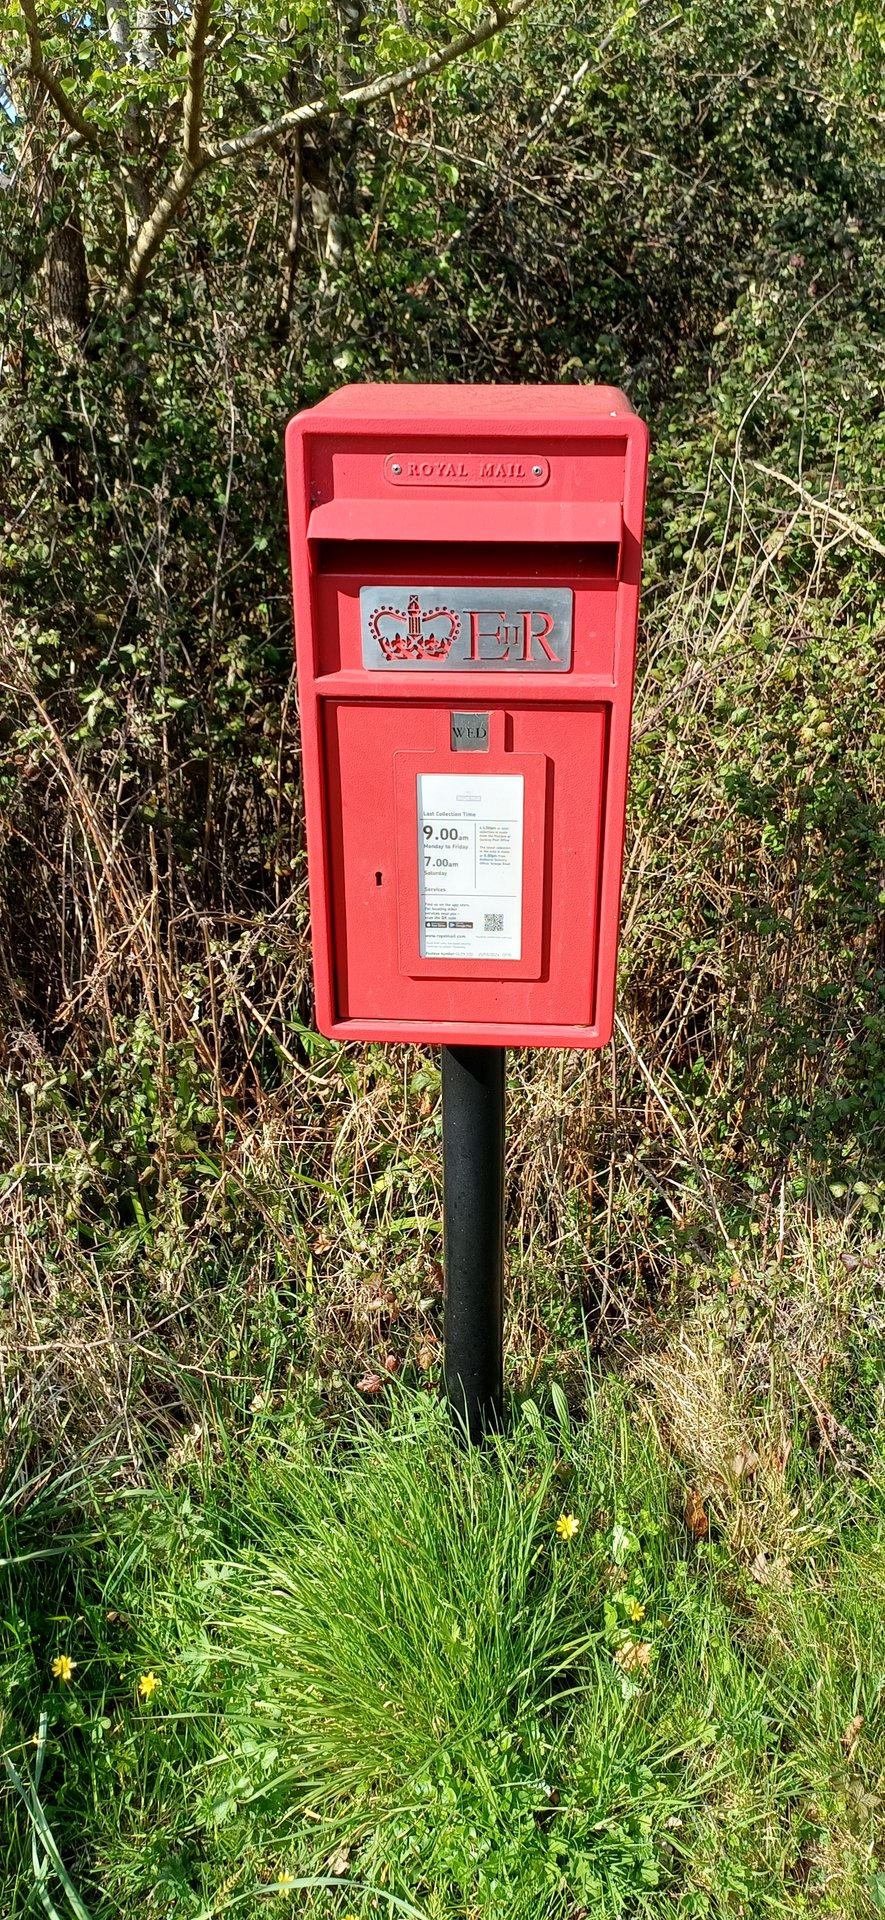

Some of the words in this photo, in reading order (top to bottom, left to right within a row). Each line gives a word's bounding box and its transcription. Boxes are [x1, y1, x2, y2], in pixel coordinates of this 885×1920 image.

[408, 462, 468, 477] ROYAL
[480, 463, 526, 478] MAIL
[452, 727, 487, 739] WED
[423, 825, 469, 840] 9.00am
[424, 856, 458, 867] 7.00am
